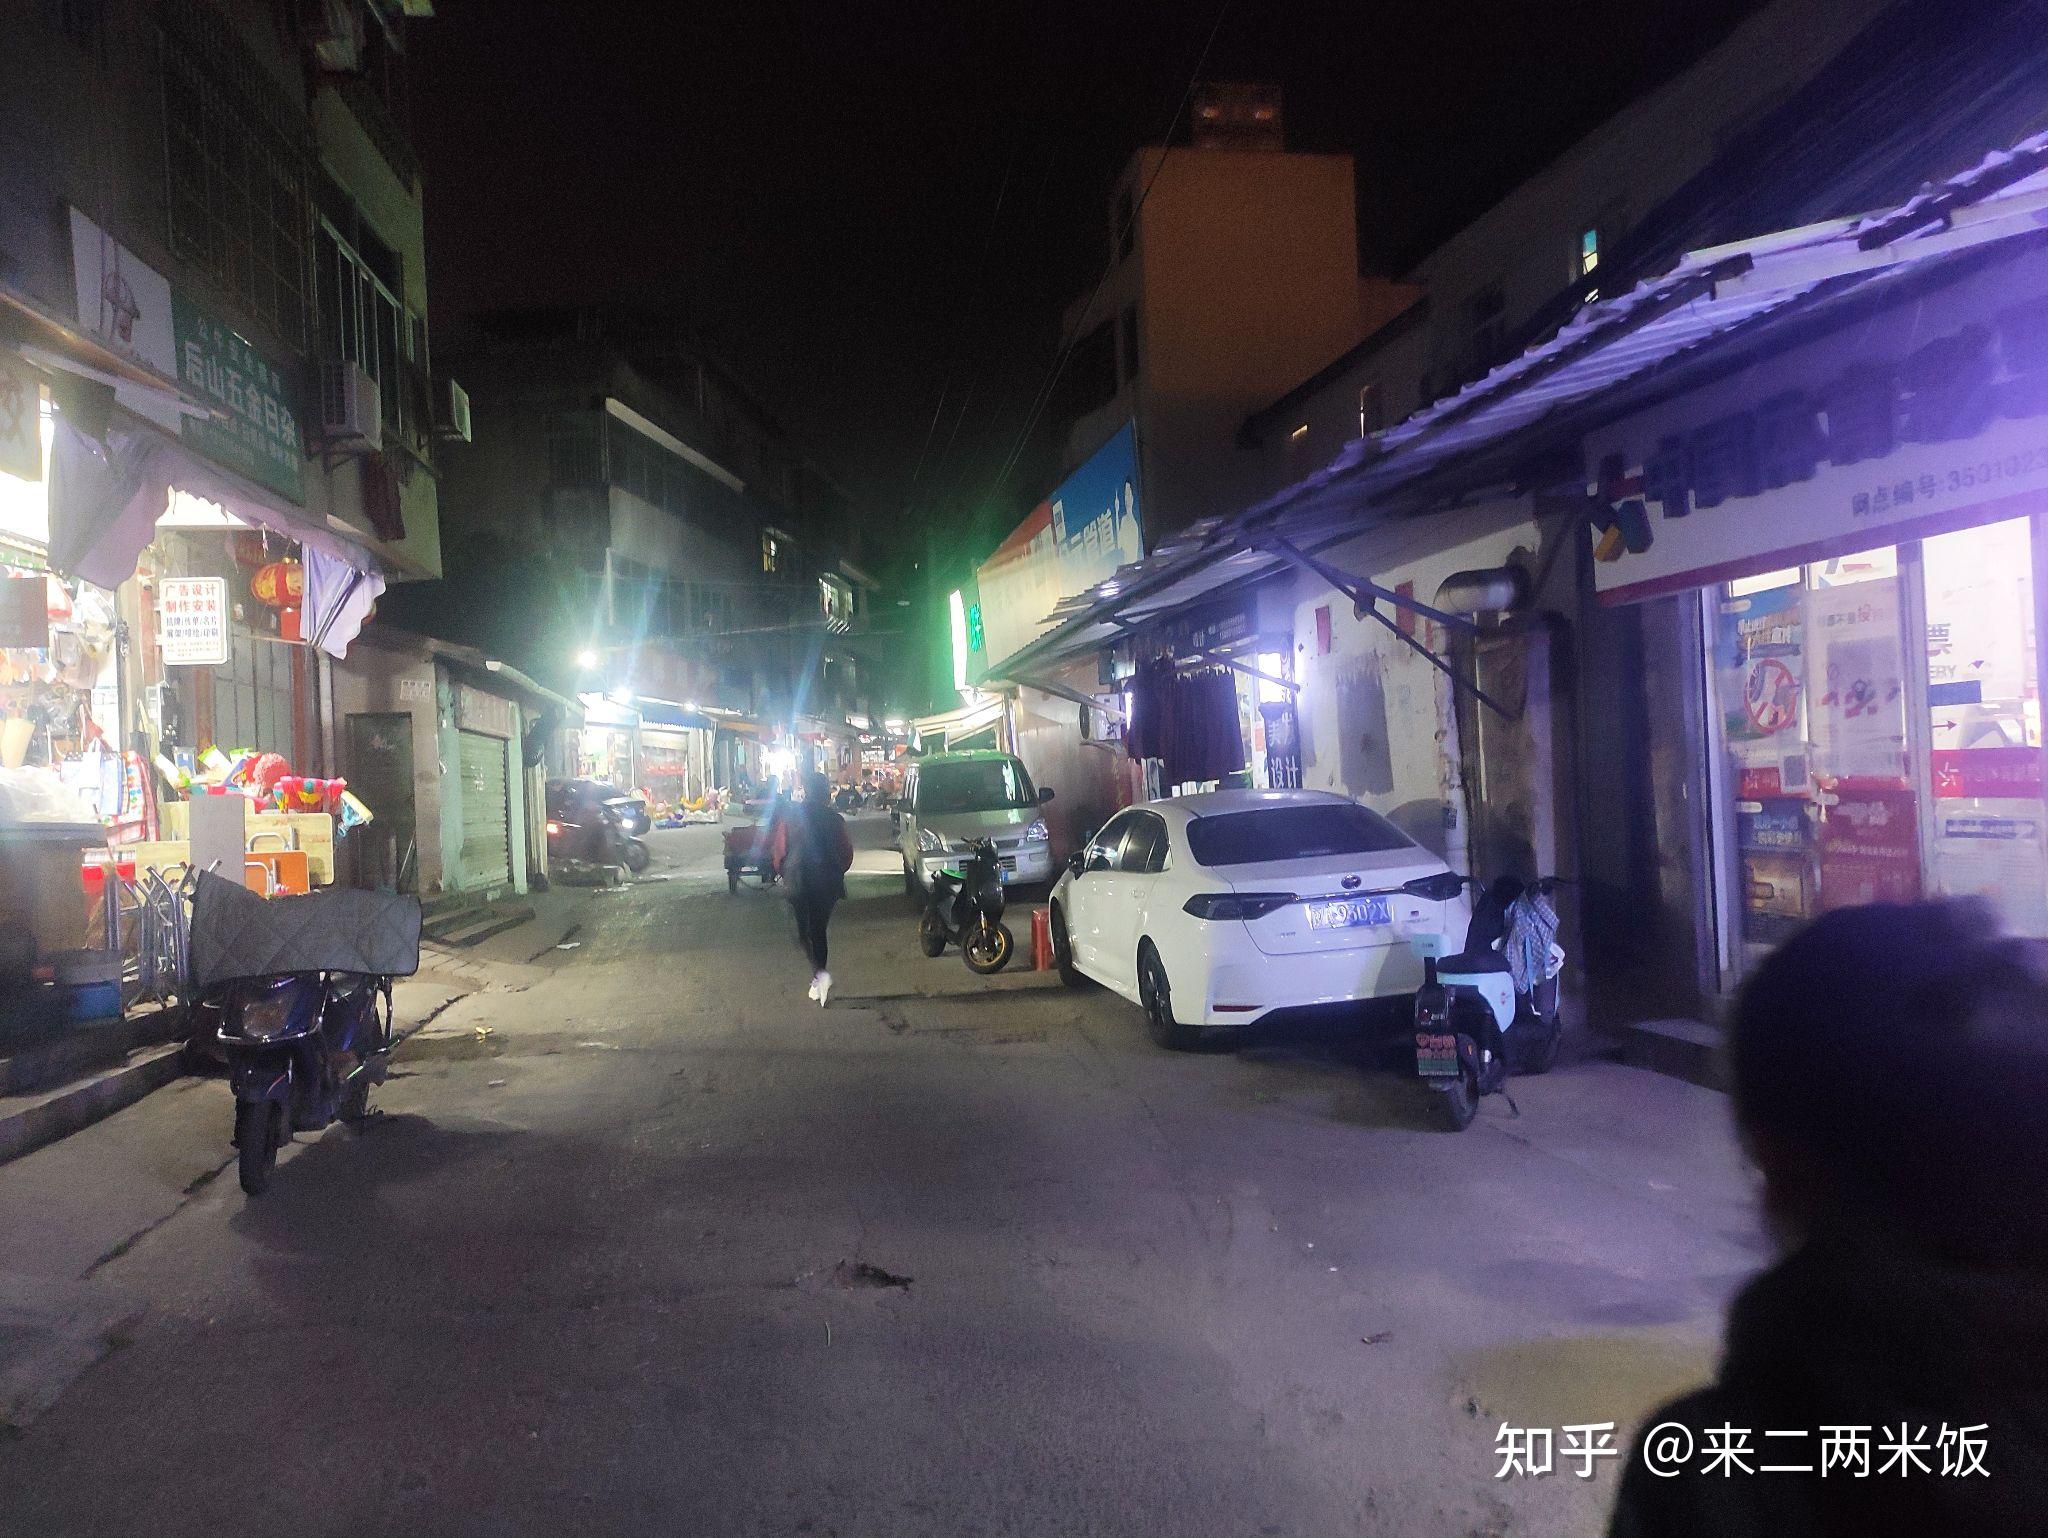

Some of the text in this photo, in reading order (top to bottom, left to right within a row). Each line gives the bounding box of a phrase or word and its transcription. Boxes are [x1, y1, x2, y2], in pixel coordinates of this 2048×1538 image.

[165, 583, 216, 597] 广告设计
[165, 600, 216, 613] 制作安装
[1271, 755, 1298, 788] 设计
